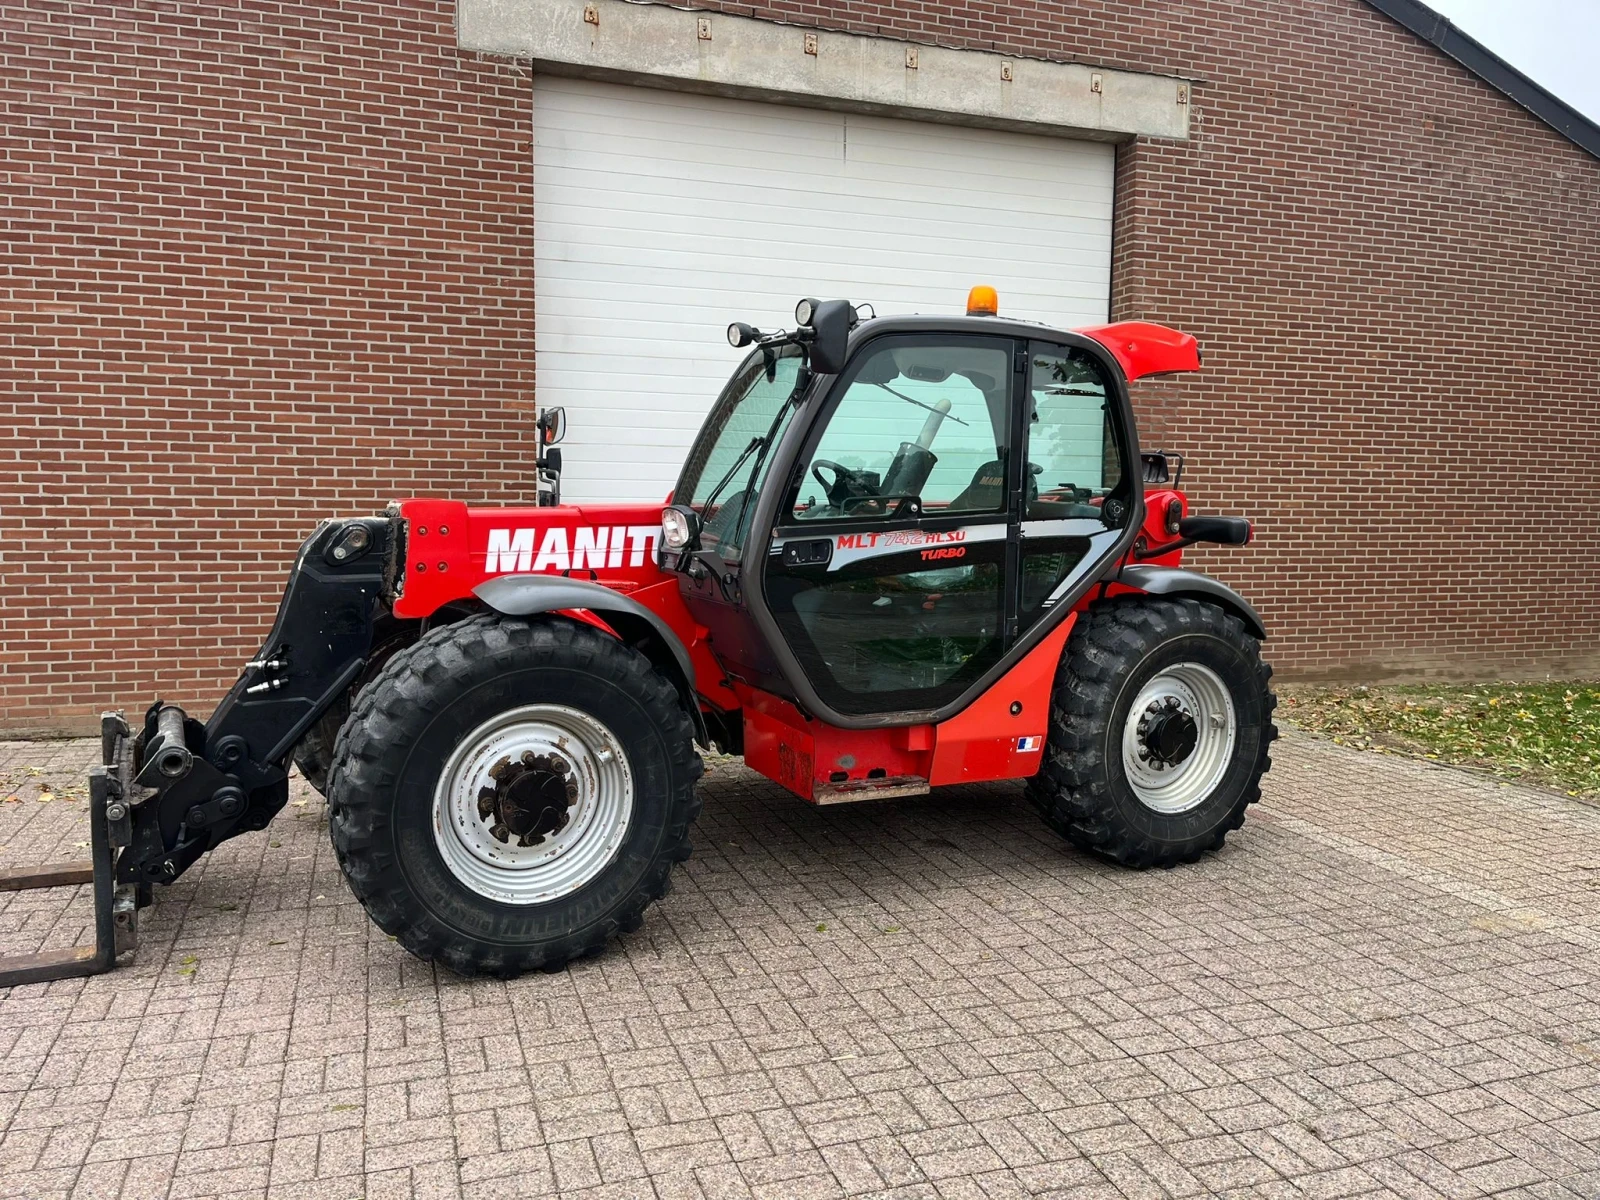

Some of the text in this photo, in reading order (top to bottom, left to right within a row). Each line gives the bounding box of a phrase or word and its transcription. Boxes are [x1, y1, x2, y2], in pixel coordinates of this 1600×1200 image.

[836, 532, 882, 550] MLT
[885, 529, 924, 547] 742
[920, 546, 967, 560] TURBO
[503, 883, 620, 936] MICHELIN
